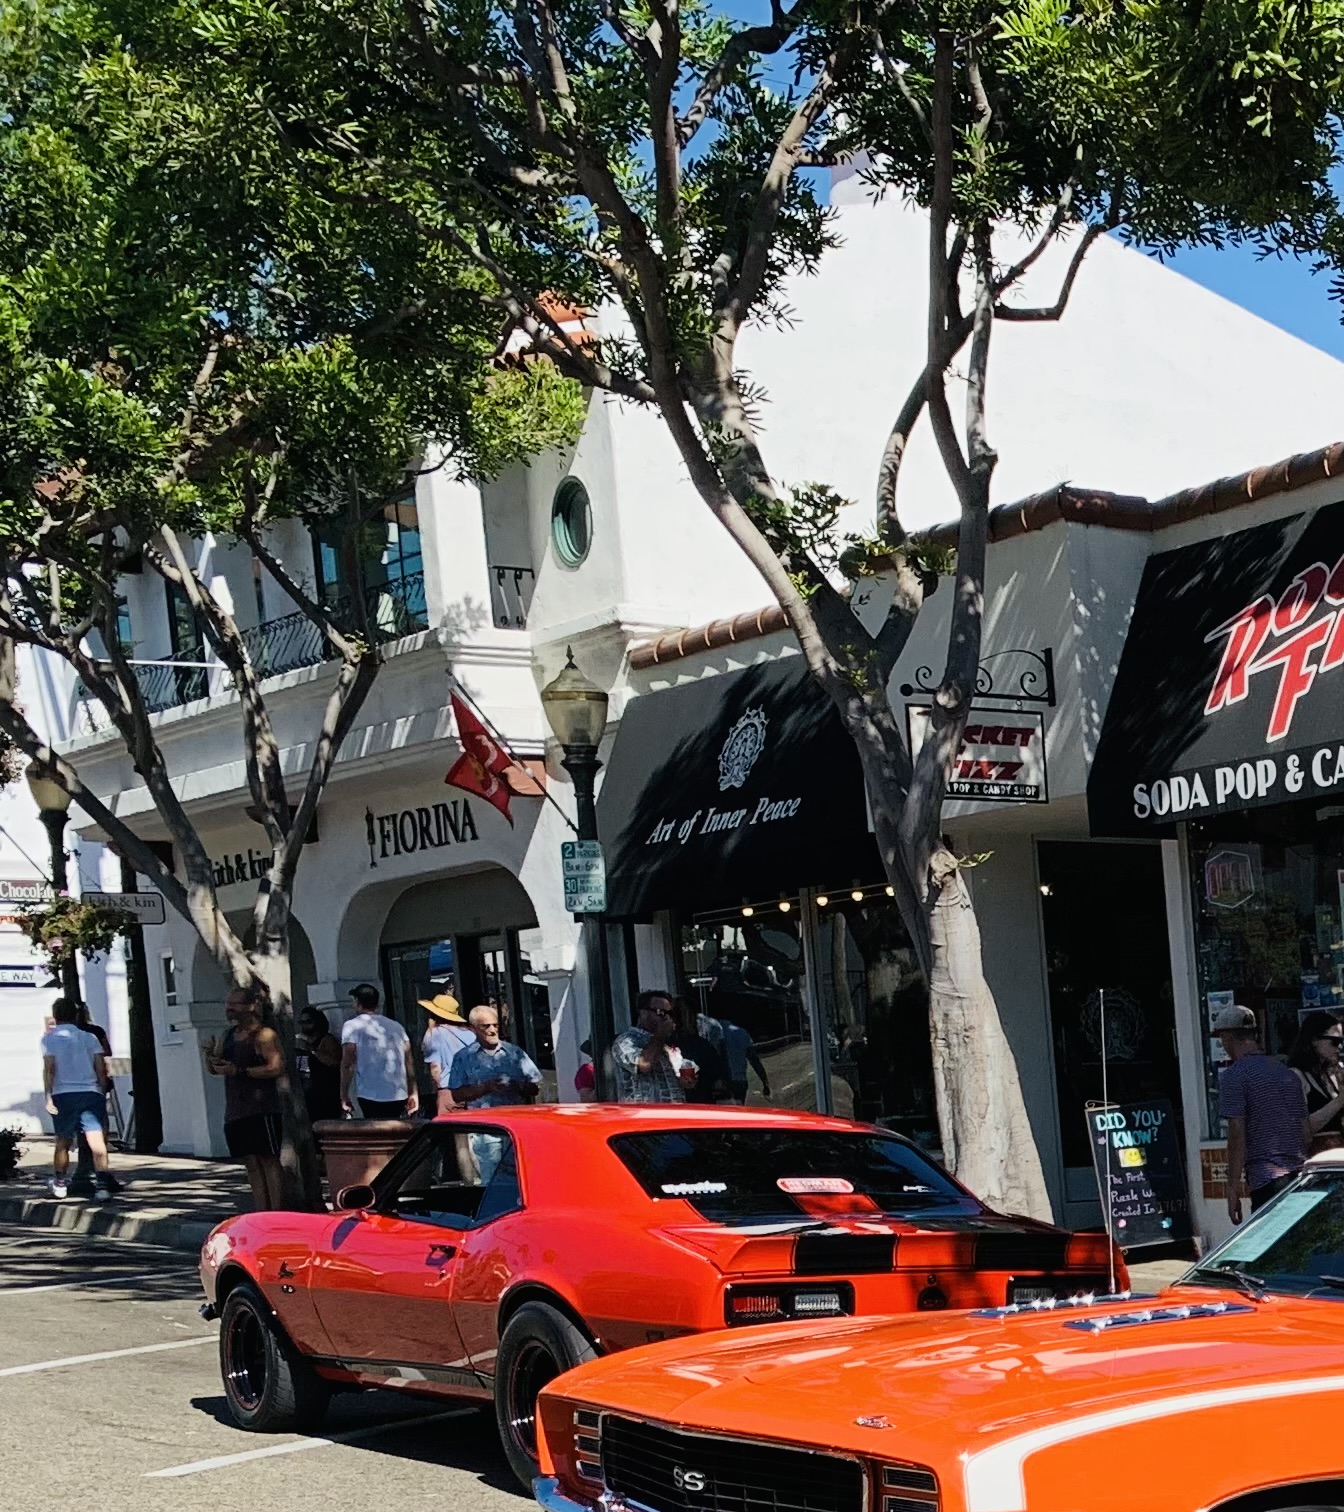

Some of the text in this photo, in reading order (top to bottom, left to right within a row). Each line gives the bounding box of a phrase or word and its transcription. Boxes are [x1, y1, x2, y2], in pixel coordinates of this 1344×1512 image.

[962, 724, 1036, 747] CKET
[953, 783, 970, 793] POP
[983, 784, 1011, 795] CANDY
[1133, 772, 1209, 820] SODA
[1215, 759, 1277, 805] POP
[1285, 753, 1305, 794] &
[376, 798, 479, 859] FIORINA
[645, 797, 802, 845] Art of Inner Peace
[564, 844, 573, 858] 2
[565, 879, 577, 893] 30
[12, 972, 35, 981] WAY
[1095, 1109, 1162, 1131] DID YOU
[1112, 1126, 1159, 1149] KNOW?
[1111, 1204, 1142, 1218] Created
[673, 1465, 705, 1492] SS
